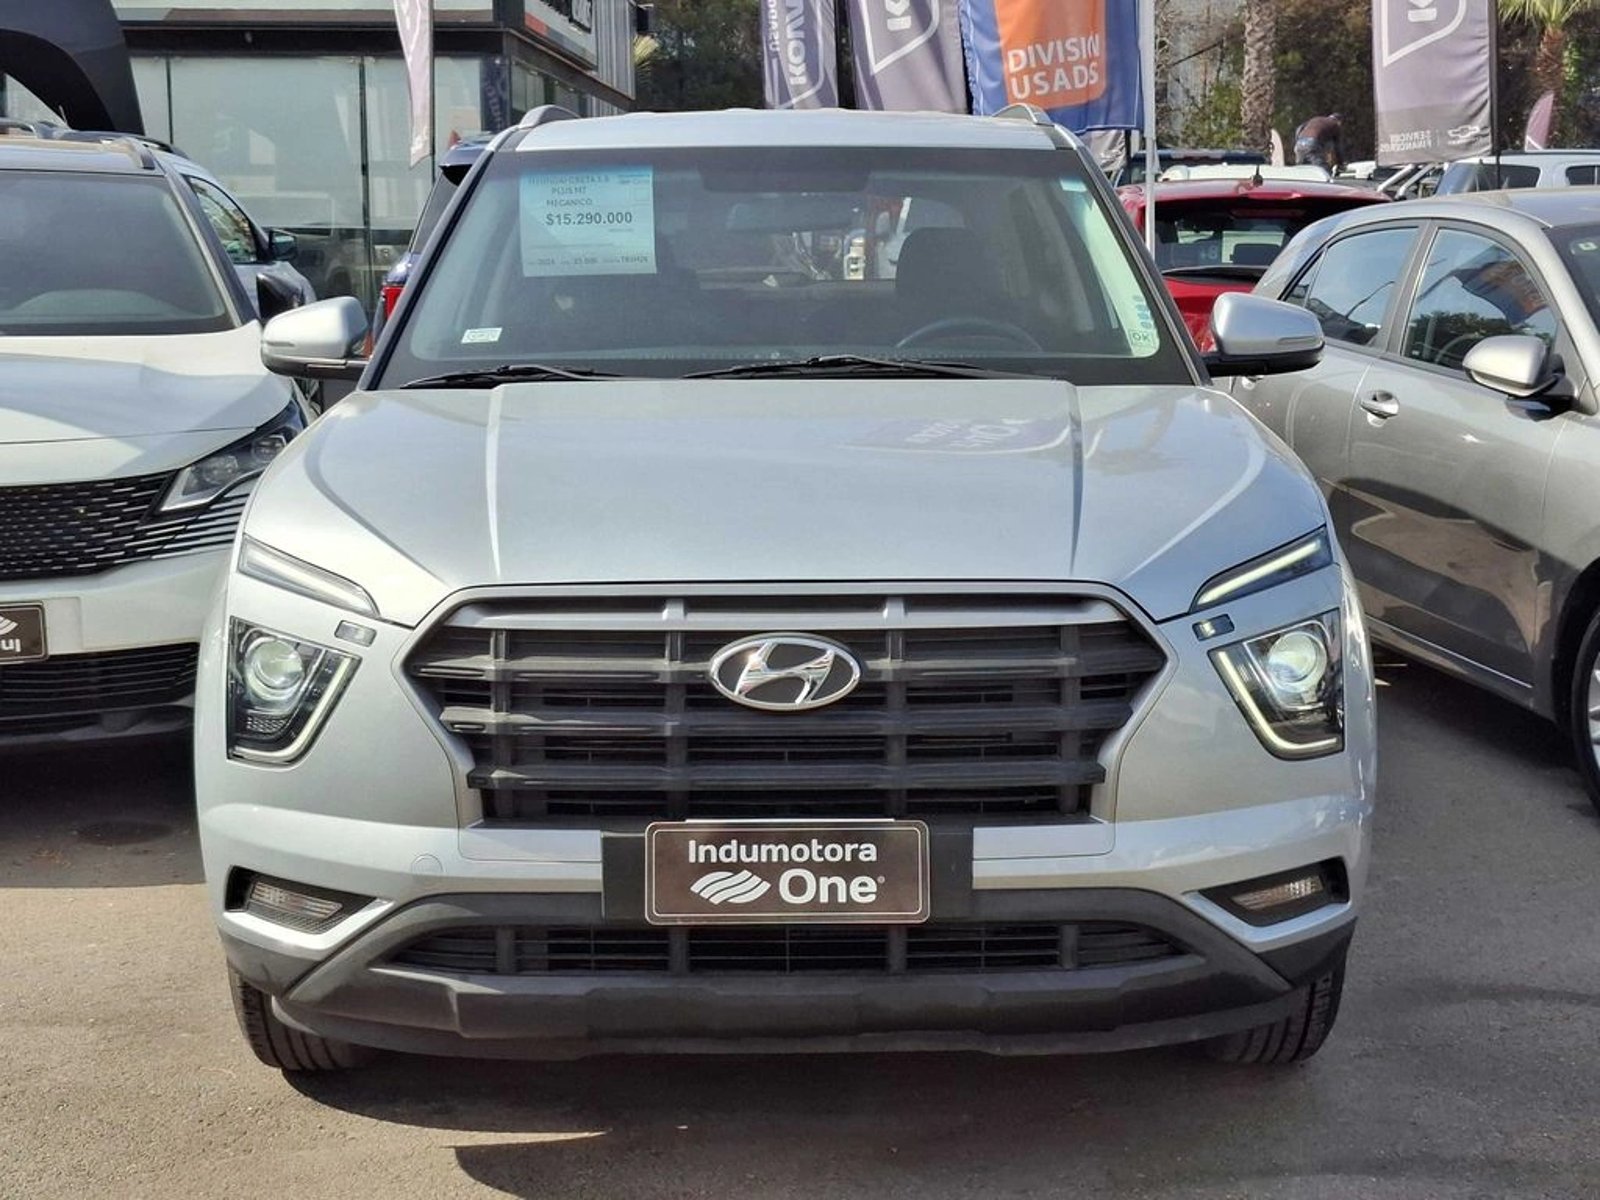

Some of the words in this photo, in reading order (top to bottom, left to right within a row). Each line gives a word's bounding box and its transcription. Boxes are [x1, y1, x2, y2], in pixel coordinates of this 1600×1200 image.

[1010, 61, 1099, 100] USADS
[545, 211, 633, 227] $15.290.000
[688, 839, 878, 864] Indumotora
